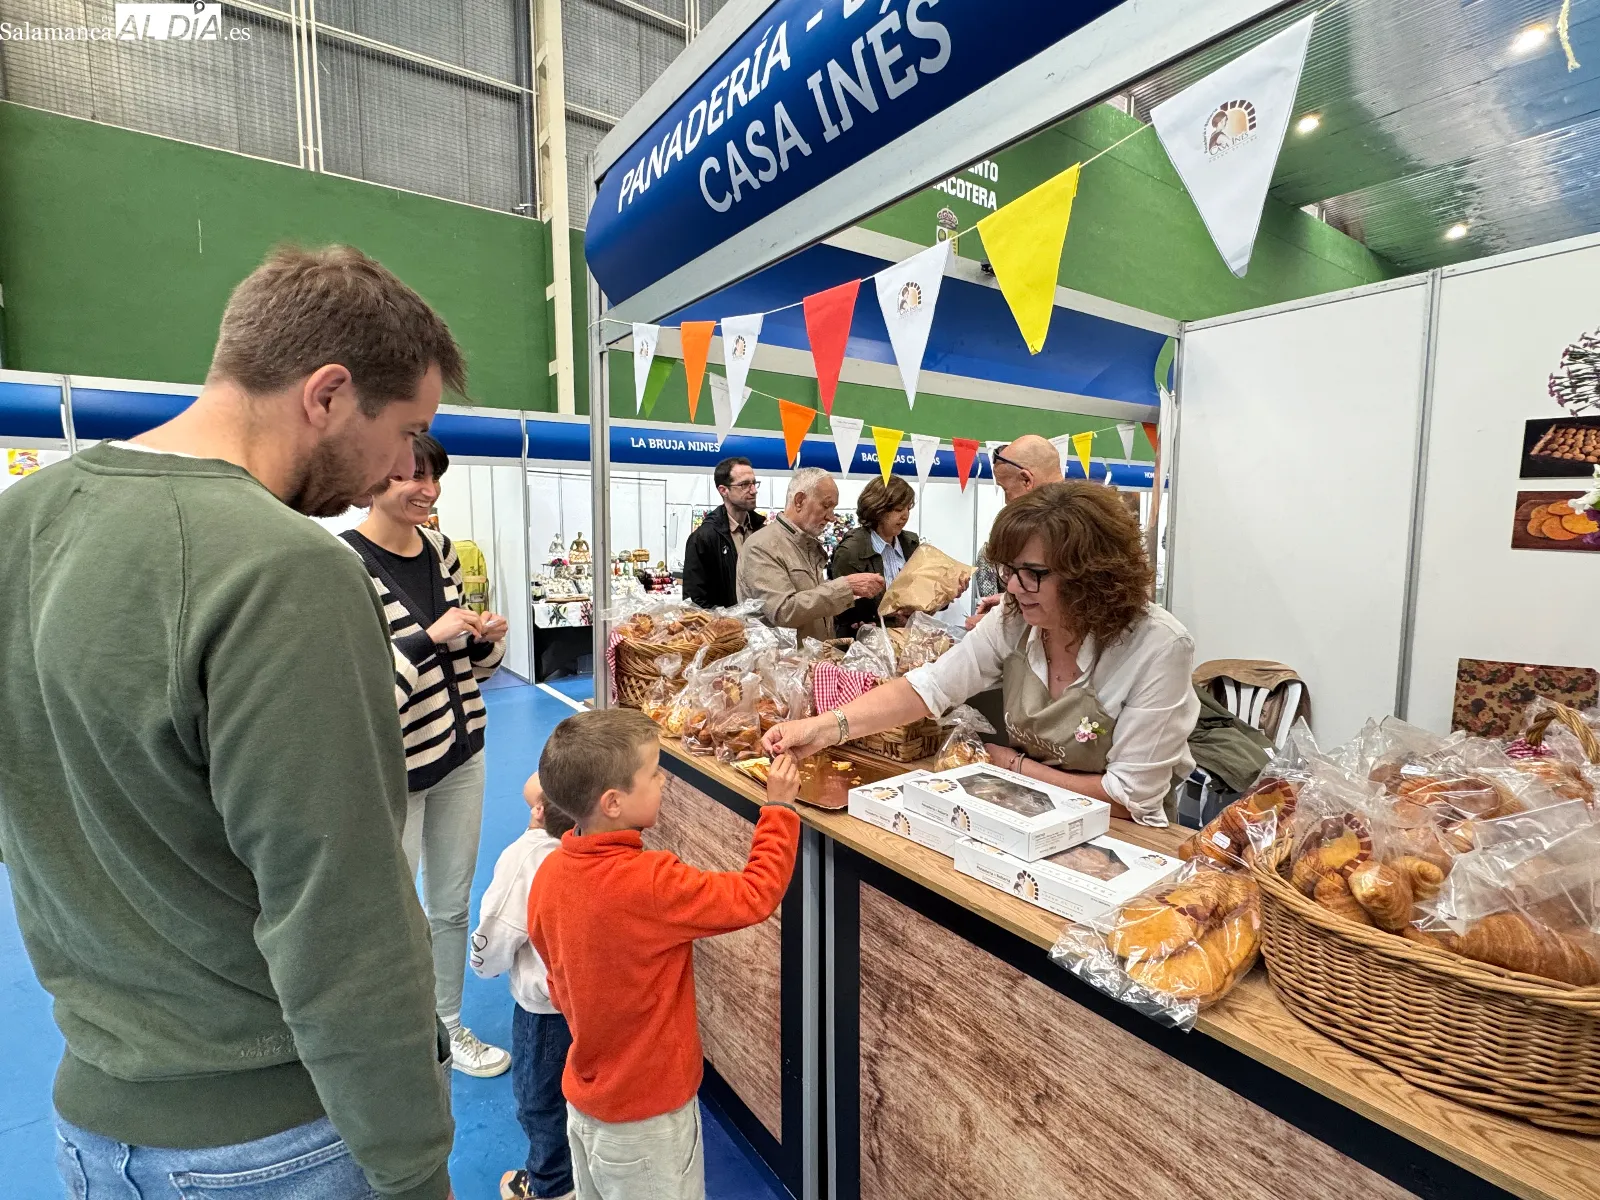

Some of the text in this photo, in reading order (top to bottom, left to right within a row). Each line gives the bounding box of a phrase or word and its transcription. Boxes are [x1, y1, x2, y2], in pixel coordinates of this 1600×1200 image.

[618, 20, 791, 213] PANADERÍA
[700, 0, 952, 213] CASA INÉS
[933, 176, 998, 211] ACOTERA
[630, 436, 720, 453] LA BRUJA NINES
